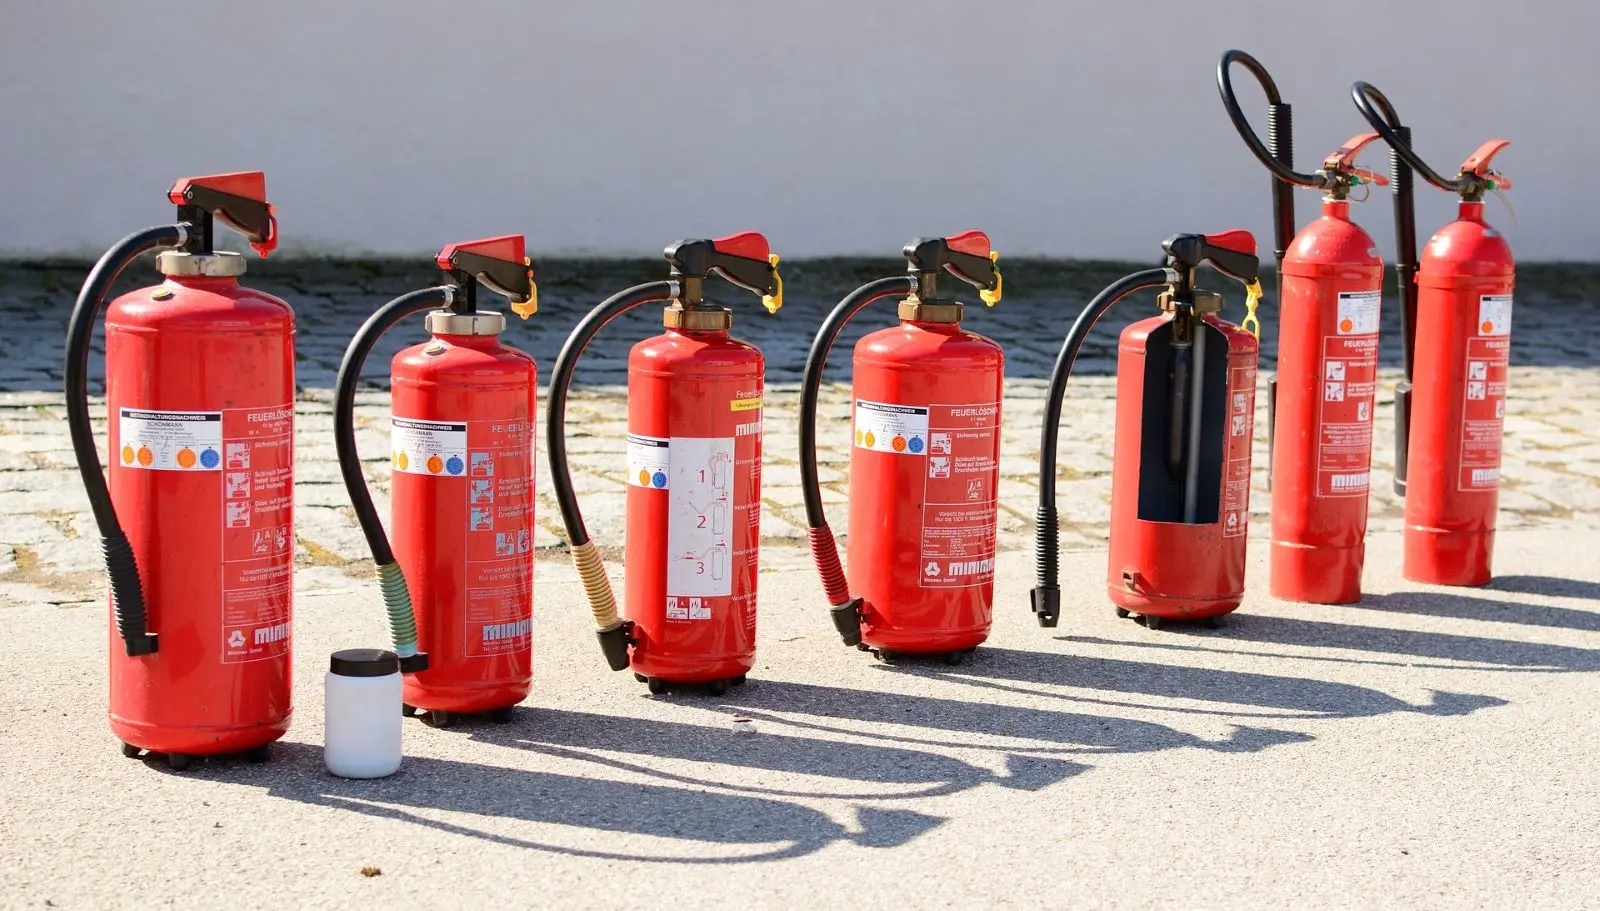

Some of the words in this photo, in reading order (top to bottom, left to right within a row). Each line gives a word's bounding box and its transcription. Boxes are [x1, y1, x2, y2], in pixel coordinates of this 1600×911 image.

[699, 469, 705, 483] 1
[696, 515, 707, 529] 2
[696, 561, 705, 575] 3
